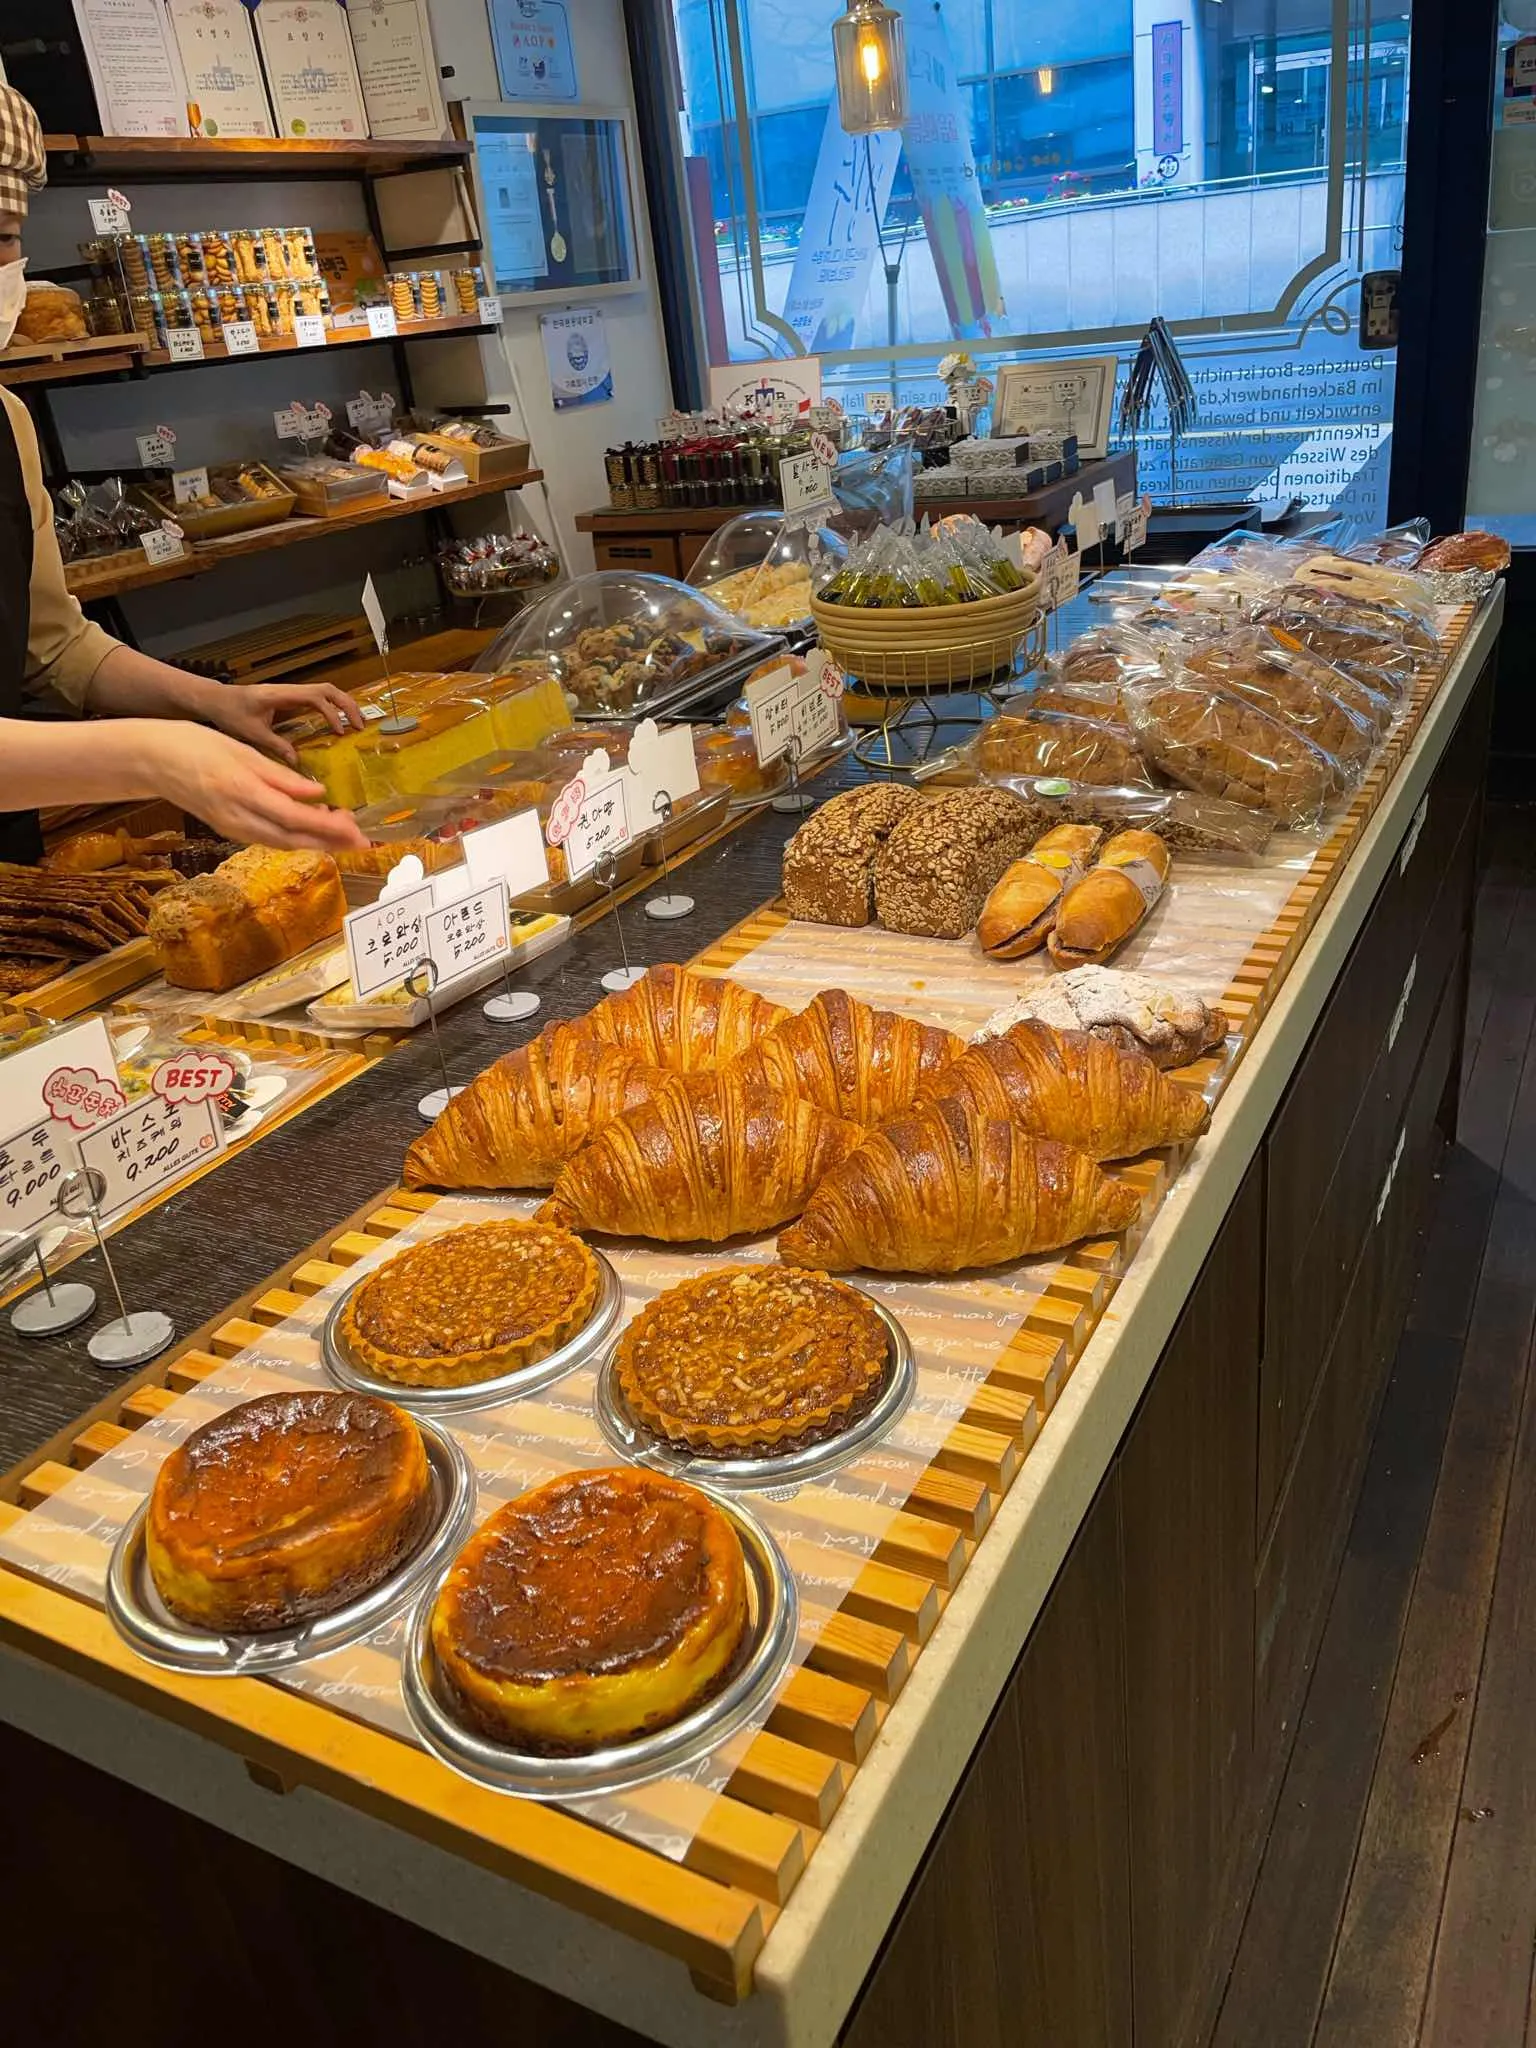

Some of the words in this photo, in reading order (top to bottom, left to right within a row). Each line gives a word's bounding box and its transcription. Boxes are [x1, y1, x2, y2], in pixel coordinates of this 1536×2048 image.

[822, 668, 841, 689] BEST
[383, 937, 419, 969] 5.000
[453, 932, 487, 960] 5.200
[165, 1068, 223, 1089] BEST
[126, 1137, 181, 1182] 9.200
[181, 1148, 199, 1163] GUTE
[6, 1163, 62, 1208] 9.000
